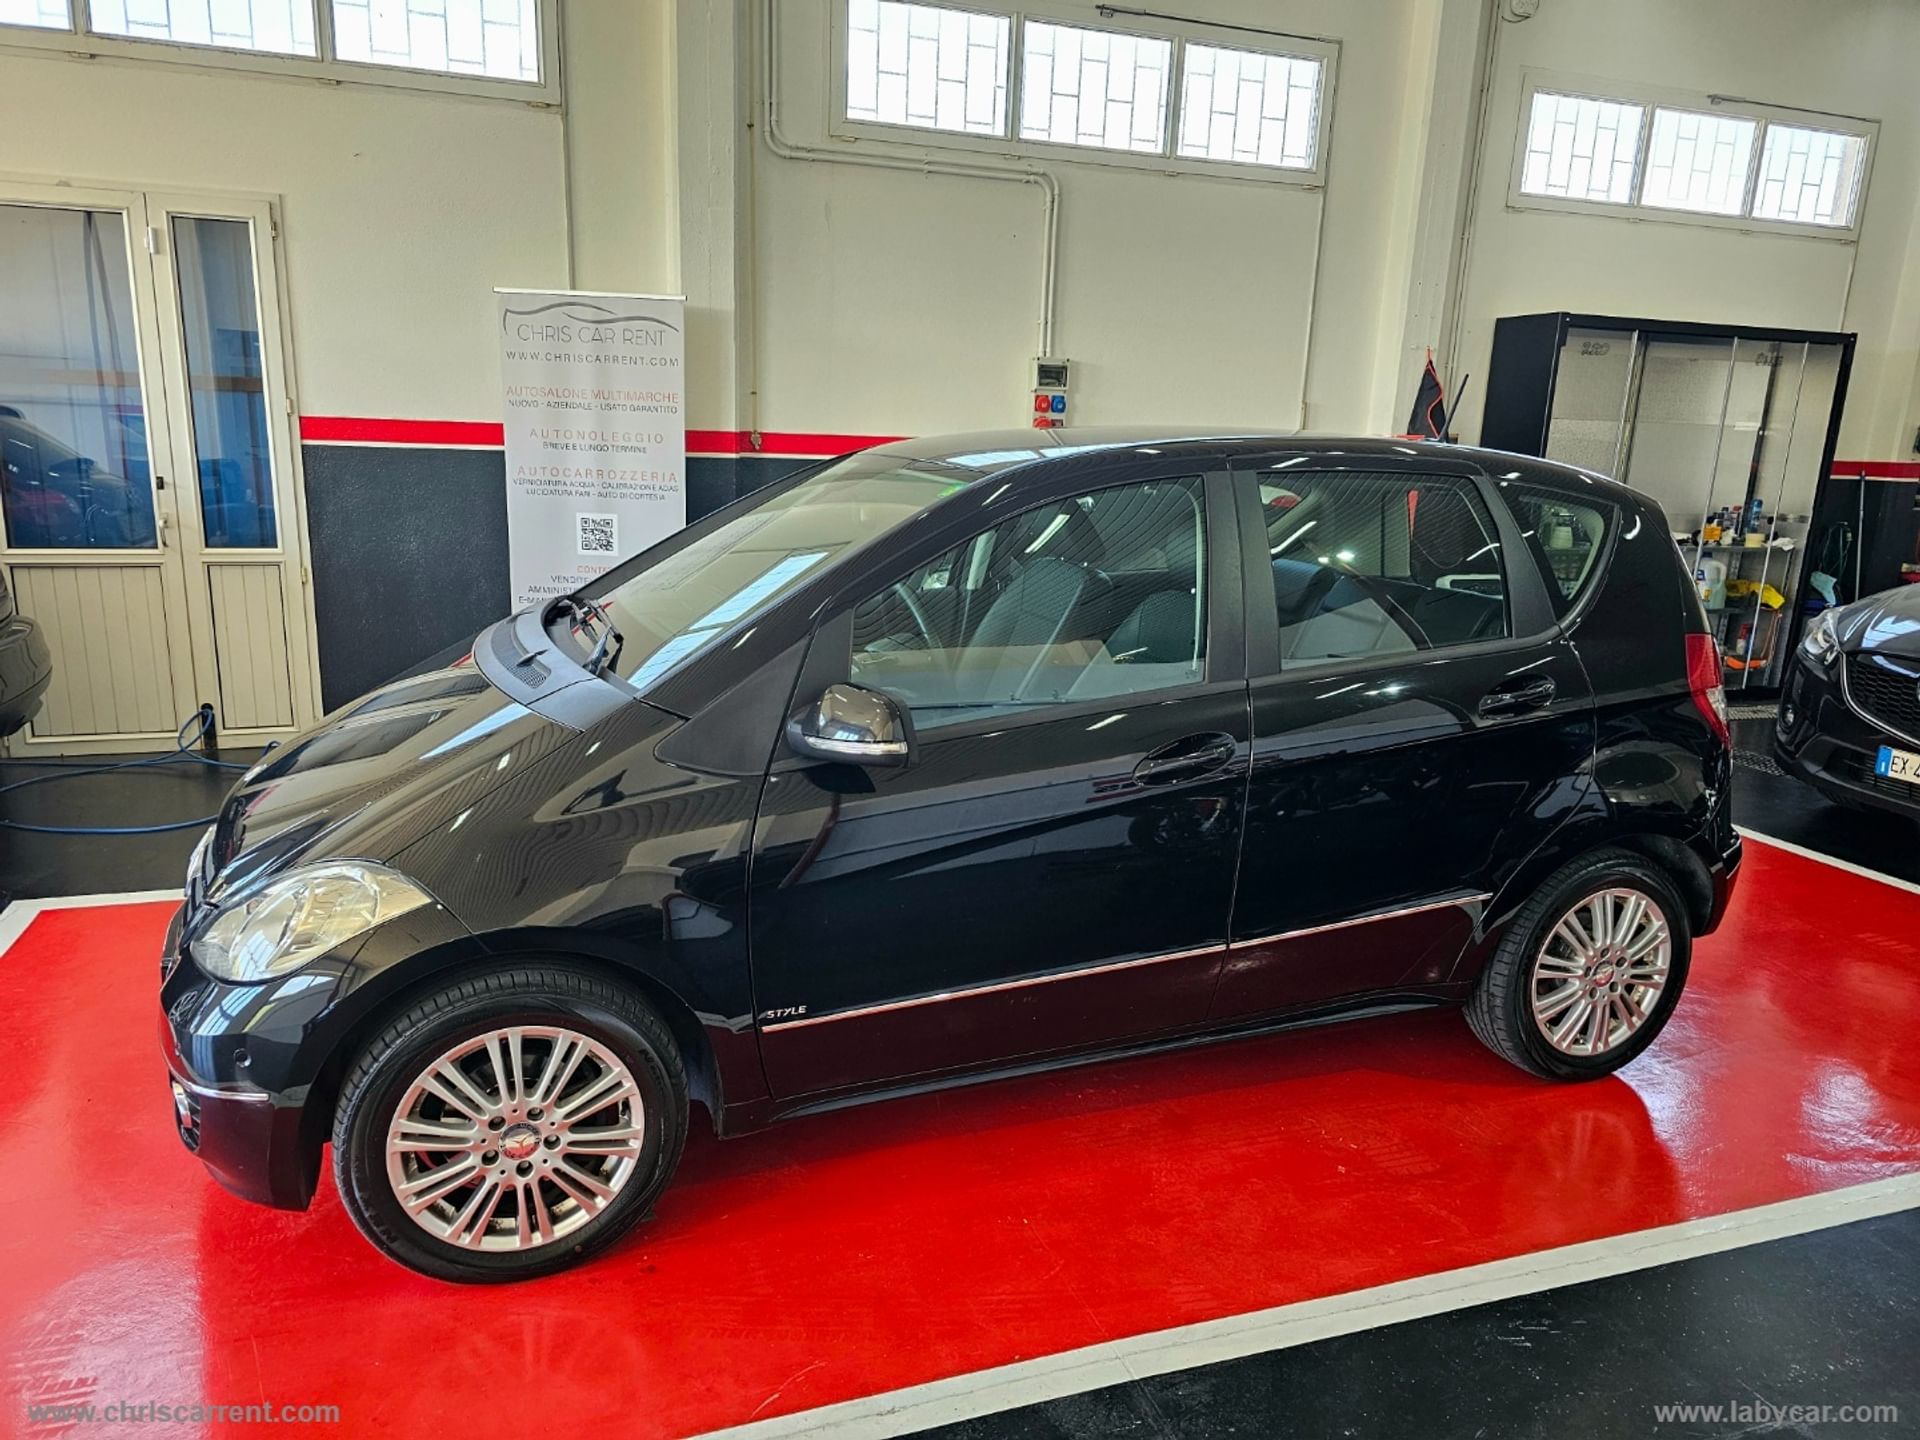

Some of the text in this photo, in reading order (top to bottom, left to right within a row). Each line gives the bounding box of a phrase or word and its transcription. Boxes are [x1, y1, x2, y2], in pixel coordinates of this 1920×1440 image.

[517, 324, 666, 346] CHRIS CAR RENT
[505, 351, 679, 367] WWW.CHRISCARRENT.COM
[506, 385, 679, 404] AUTOSALONE MULTIMARCHE
[508, 399, 539, 408] NUOVO
[546, 400, 593, 410] AZIENDALE
[600, 402, 628, 412] USATO
[629, 404, 678, 414] GARANTITO
[529, 428, 664, 444] AUTONOLEGGIO
[517, 466, 678, 482] AUTOCARROZZERIA
[767, 1005, 807, 1018] STYLE
